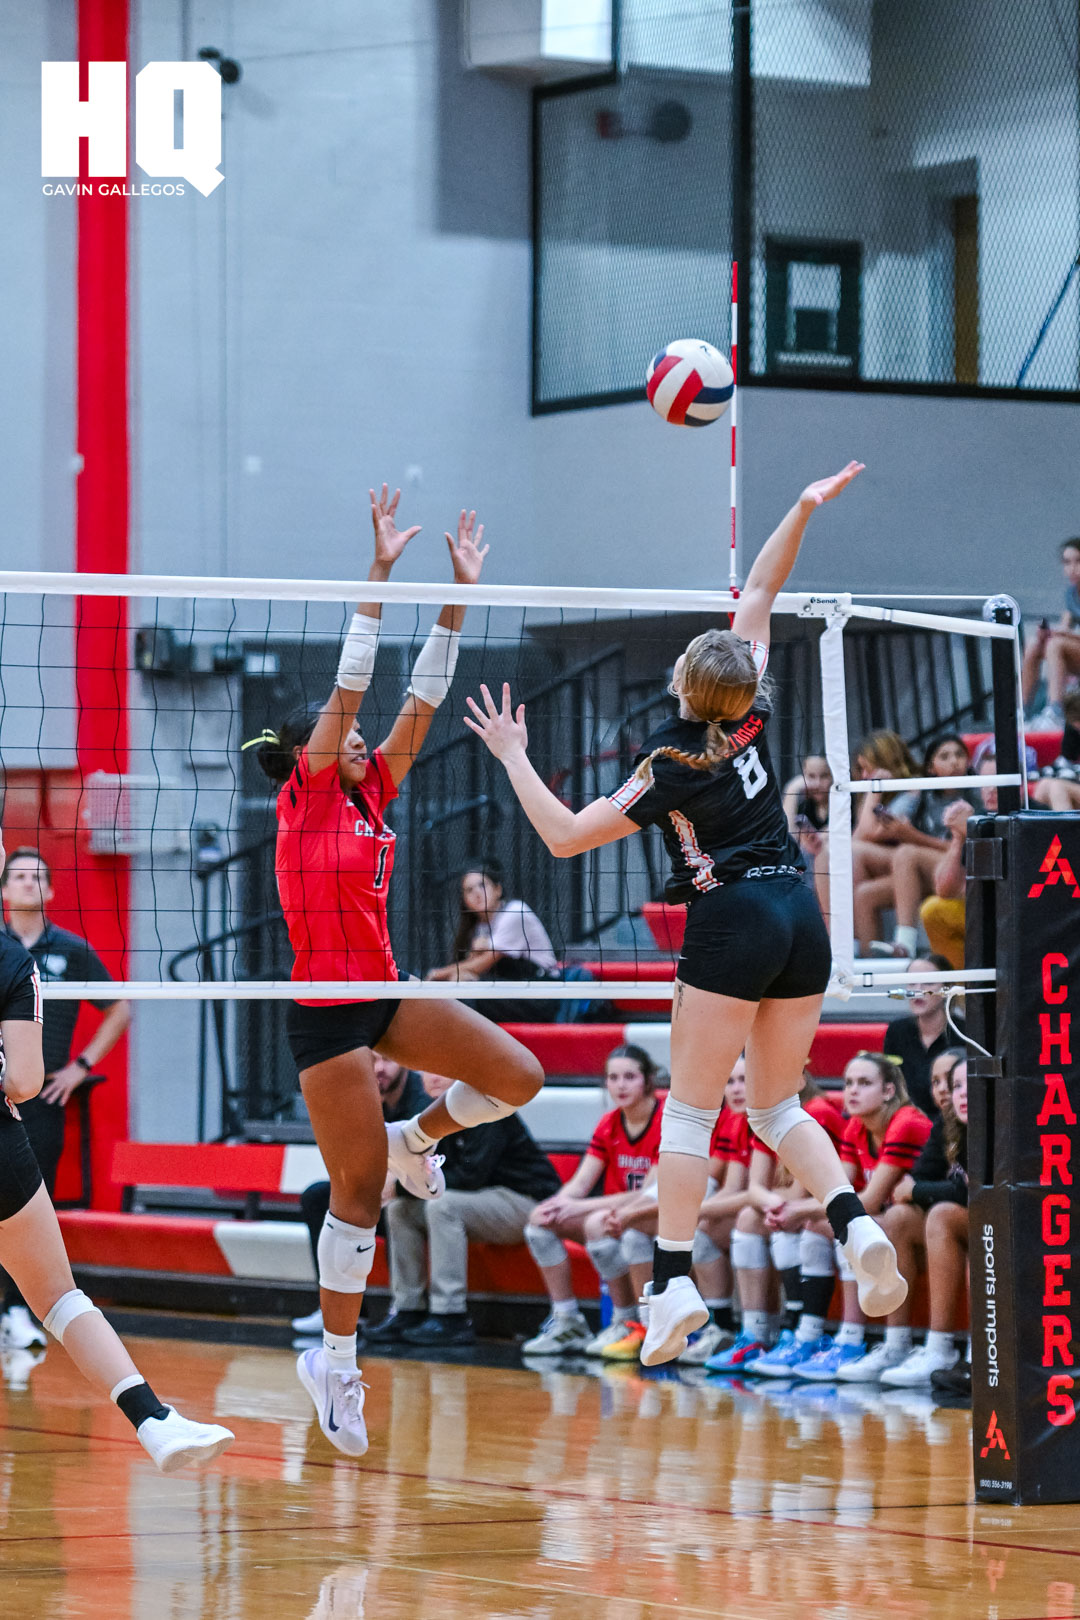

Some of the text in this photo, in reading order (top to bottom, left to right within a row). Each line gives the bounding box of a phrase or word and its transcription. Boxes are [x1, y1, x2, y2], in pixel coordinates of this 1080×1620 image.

[733, 745, 768, 800] 8
[373, 844, 391, 889] 1
[1037, 952, 1077, 1426] CHARGERS
[981, 1224, 999, 1388] sports imports
